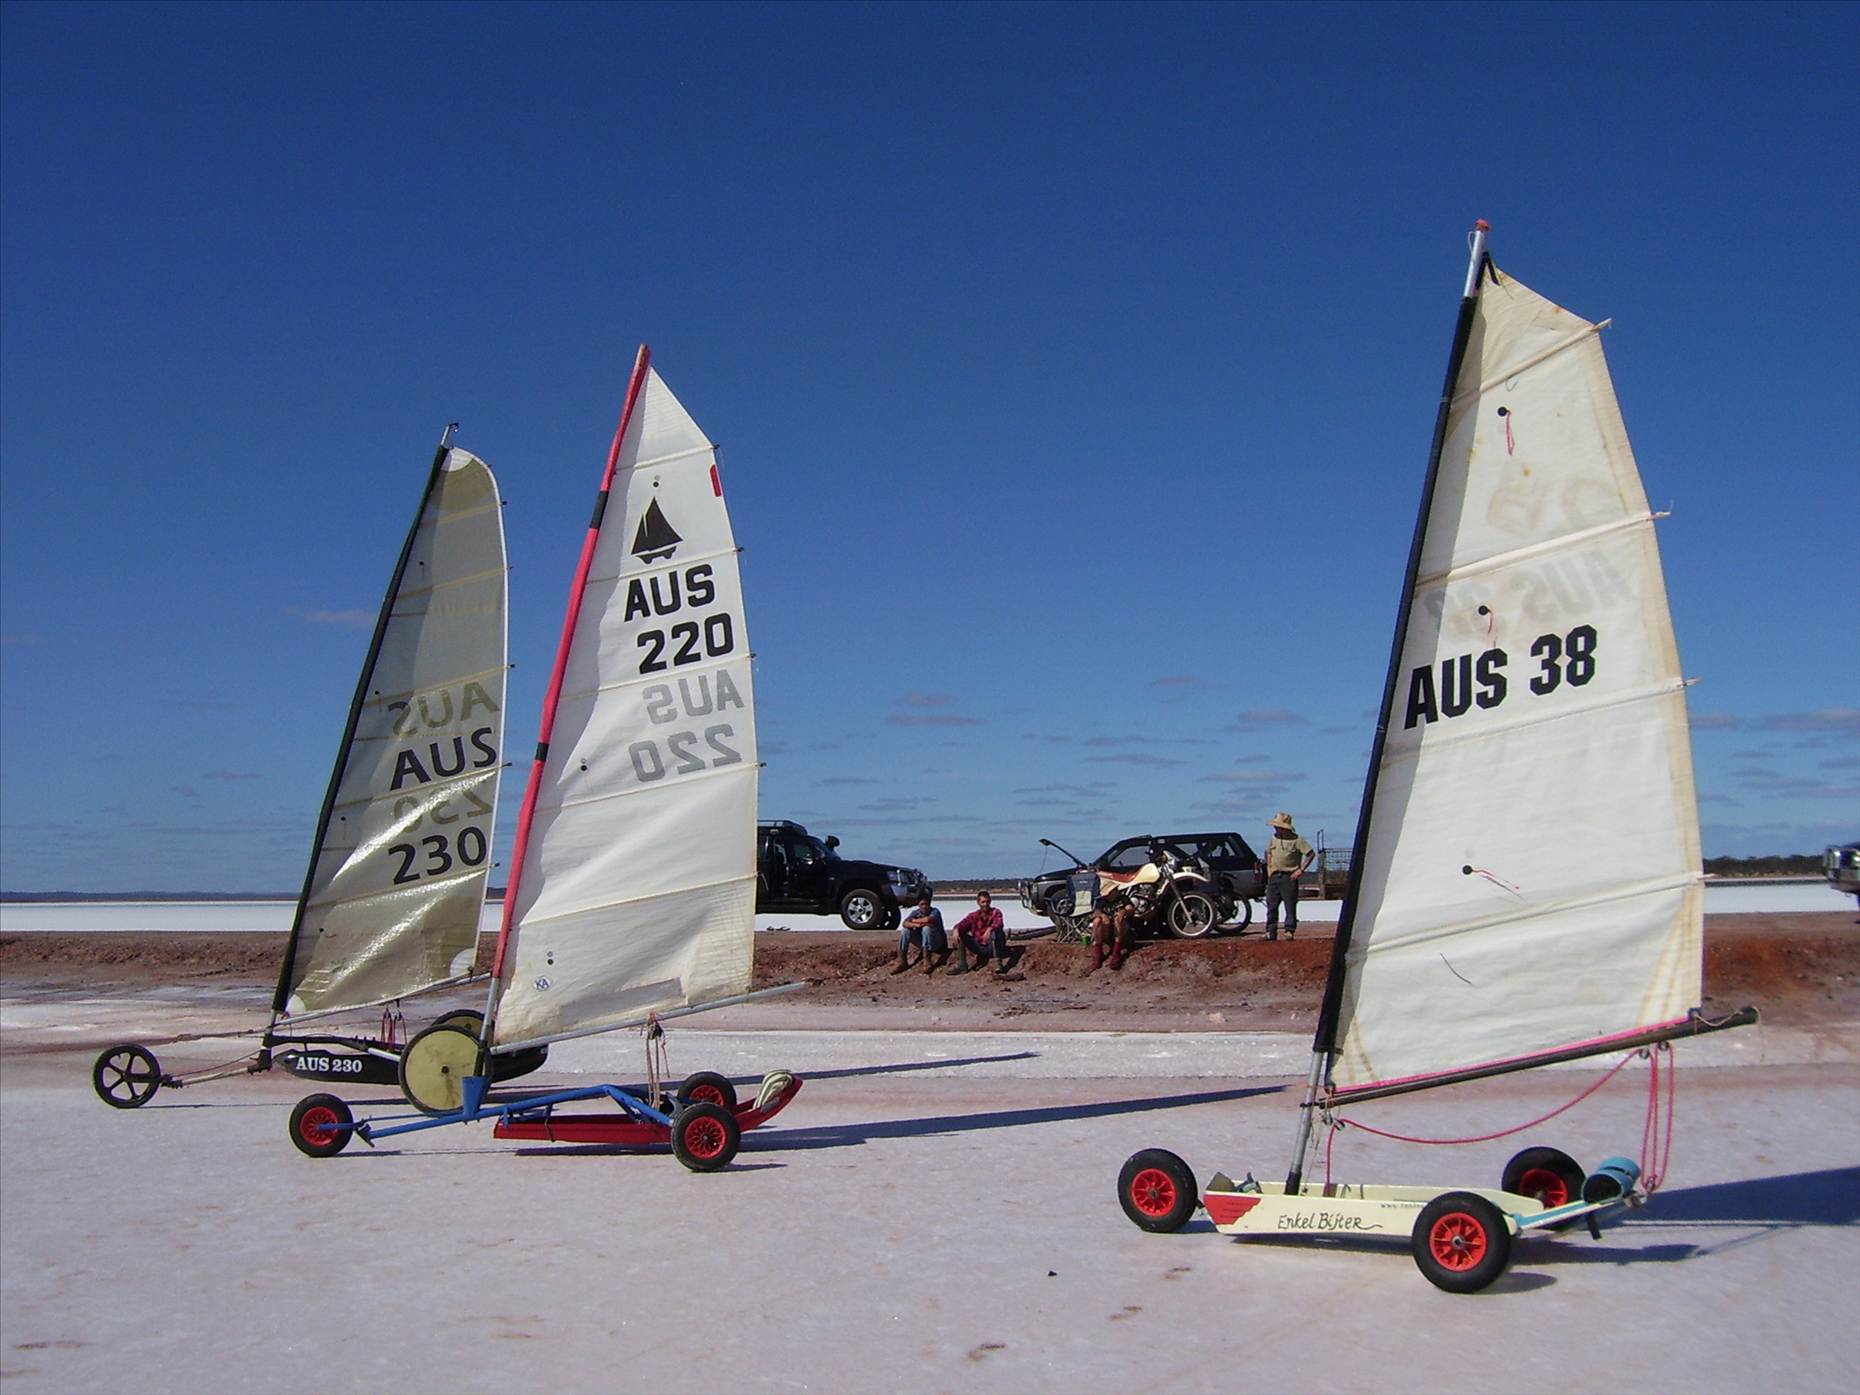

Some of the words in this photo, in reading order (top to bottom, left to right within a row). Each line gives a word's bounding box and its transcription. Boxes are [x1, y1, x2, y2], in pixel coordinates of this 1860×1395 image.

[624, 563, 716, 622] AUS
[637, 612, 734, 675] 220
[1404, 648, 1508, 729] AUS
[1530, 624, 1598, 696] 38
[389, 727, 497, 791] AUS
[388, 826, 487, 885] 230
[295, 1056, 330, 1071] AUS
[332, 1060, 363, 1073] 230
[1278, 1212, 1316, 1229] Enkel
